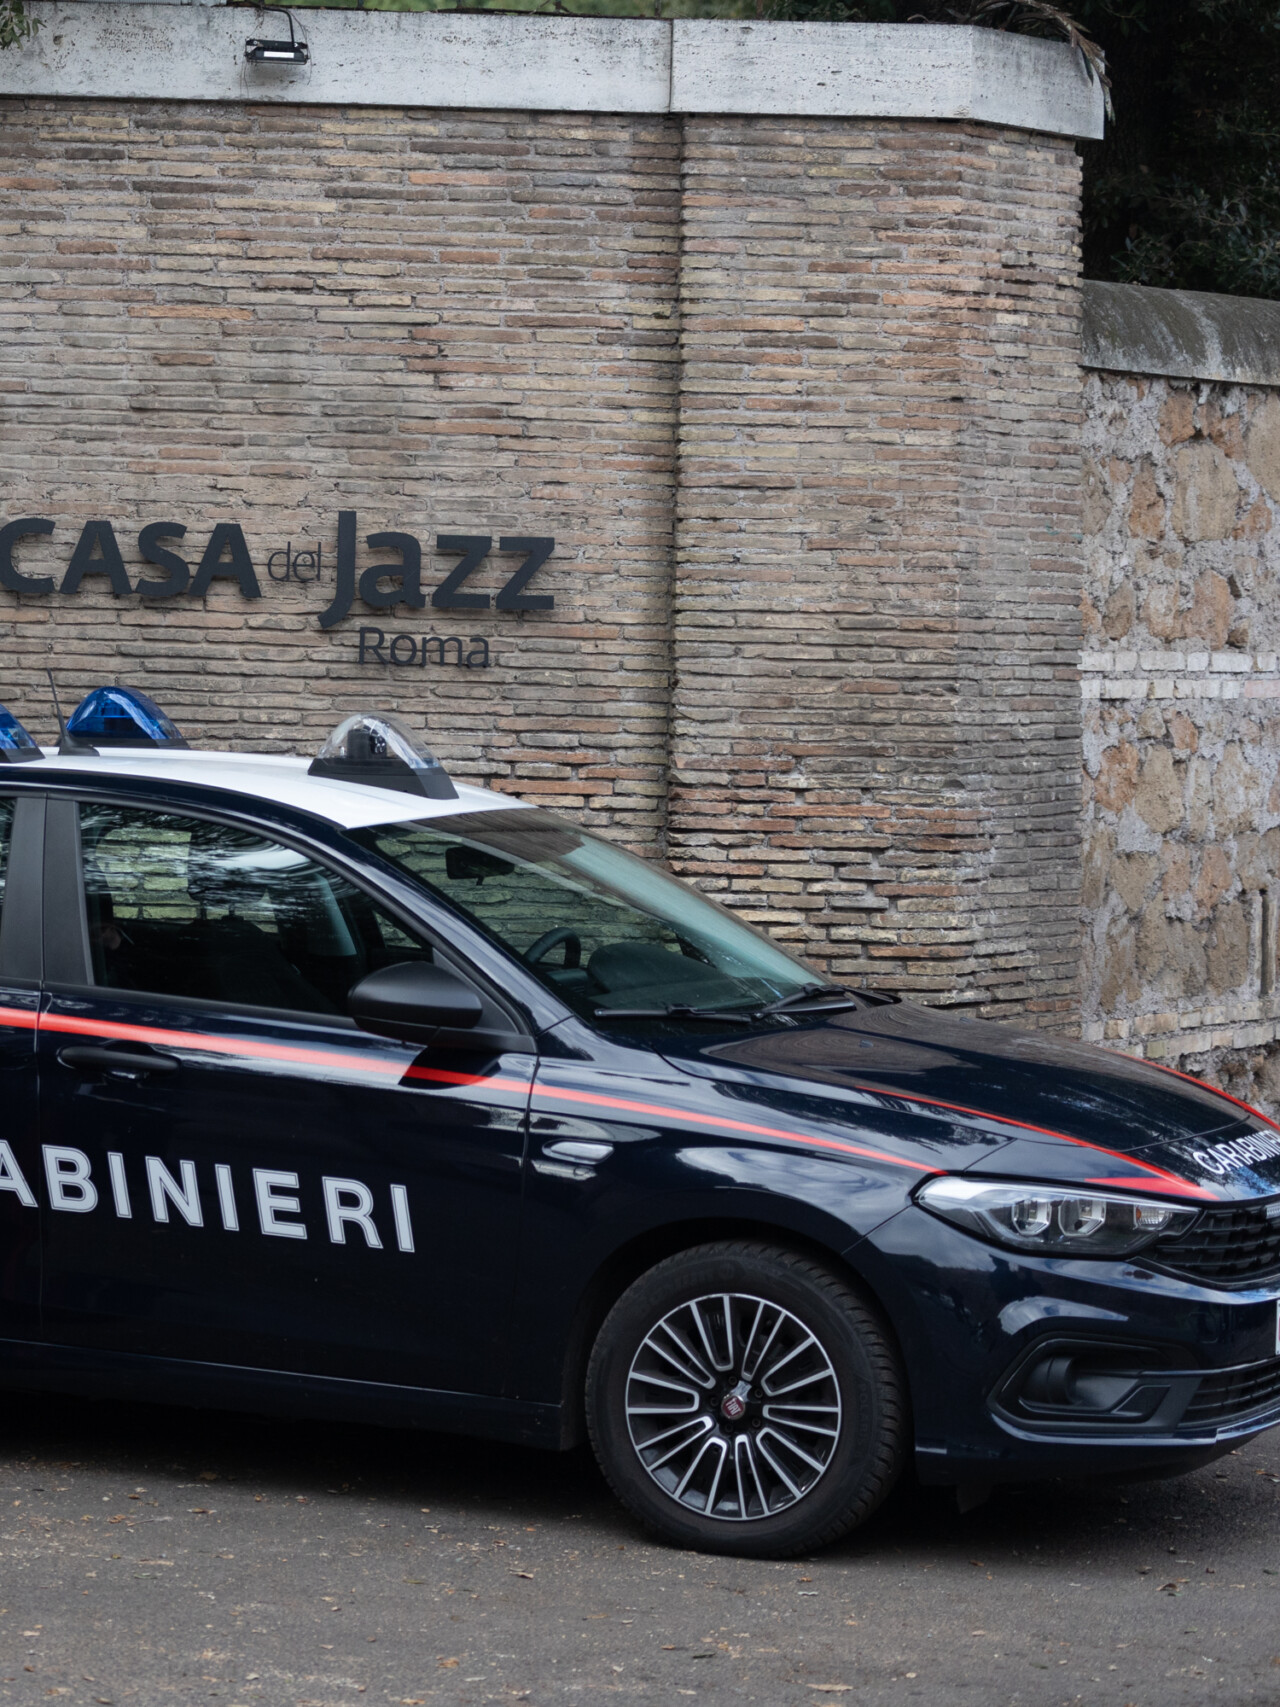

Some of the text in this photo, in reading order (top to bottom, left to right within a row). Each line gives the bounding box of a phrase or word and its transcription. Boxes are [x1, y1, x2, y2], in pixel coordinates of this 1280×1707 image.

[267, 540, 322, 583] del
[318, 510, 555, 629] Jazz
[358, 626, 490, 669] Roma
